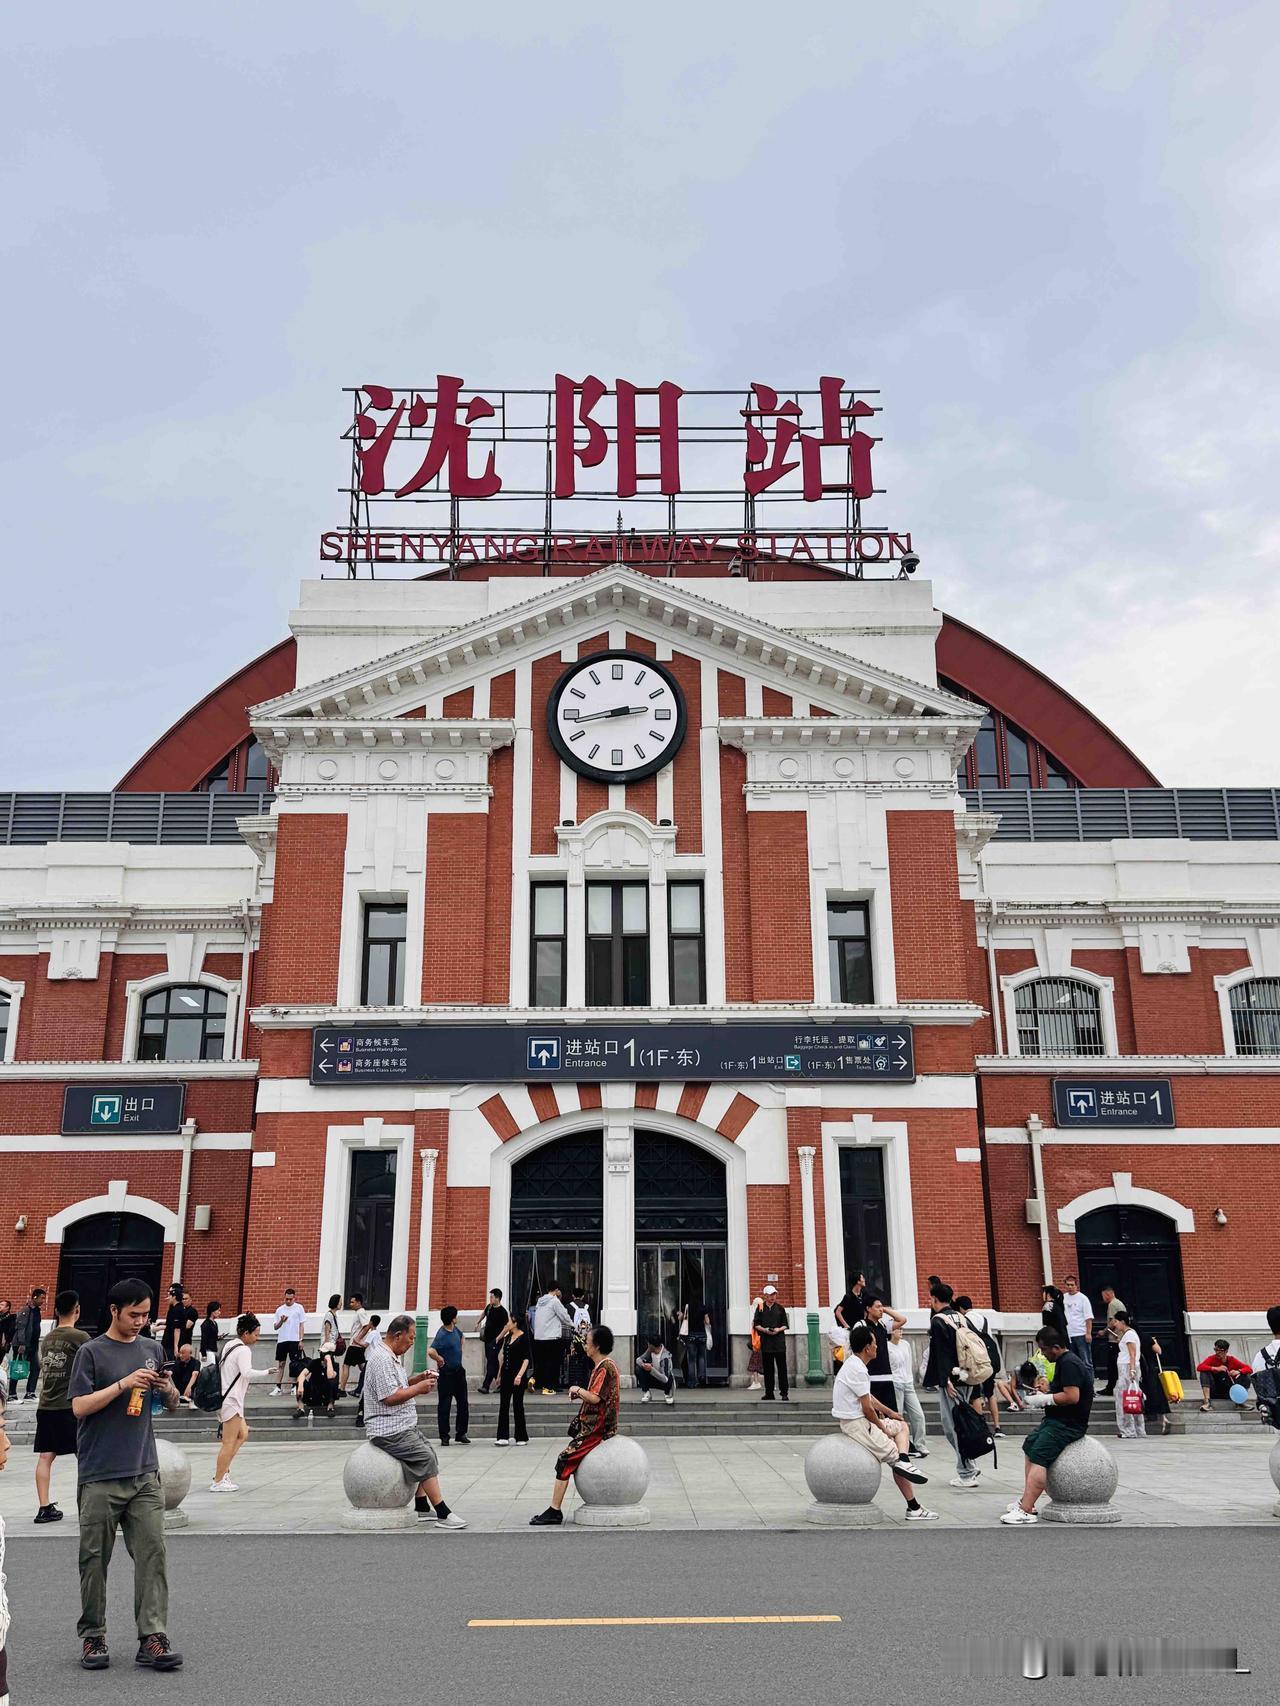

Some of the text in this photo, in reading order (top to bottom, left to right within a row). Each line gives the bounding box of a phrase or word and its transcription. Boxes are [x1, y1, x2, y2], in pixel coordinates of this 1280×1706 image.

[356, 373, 875, 502] 沈阳站
[322, 532, 911, 561] SHENYANG RAILWAY STATION
[356, 1038, 399, 1047] 商务候车室
[355, 1058, 407, 1067] 商务座候车区
[565, 1059, 607, 1067] Entrance
[125, 1096, 154, 1111] 出口
[1100, 1107, 1138, 1115] Entrance
[124, 1113, 139, 1121] Exit
